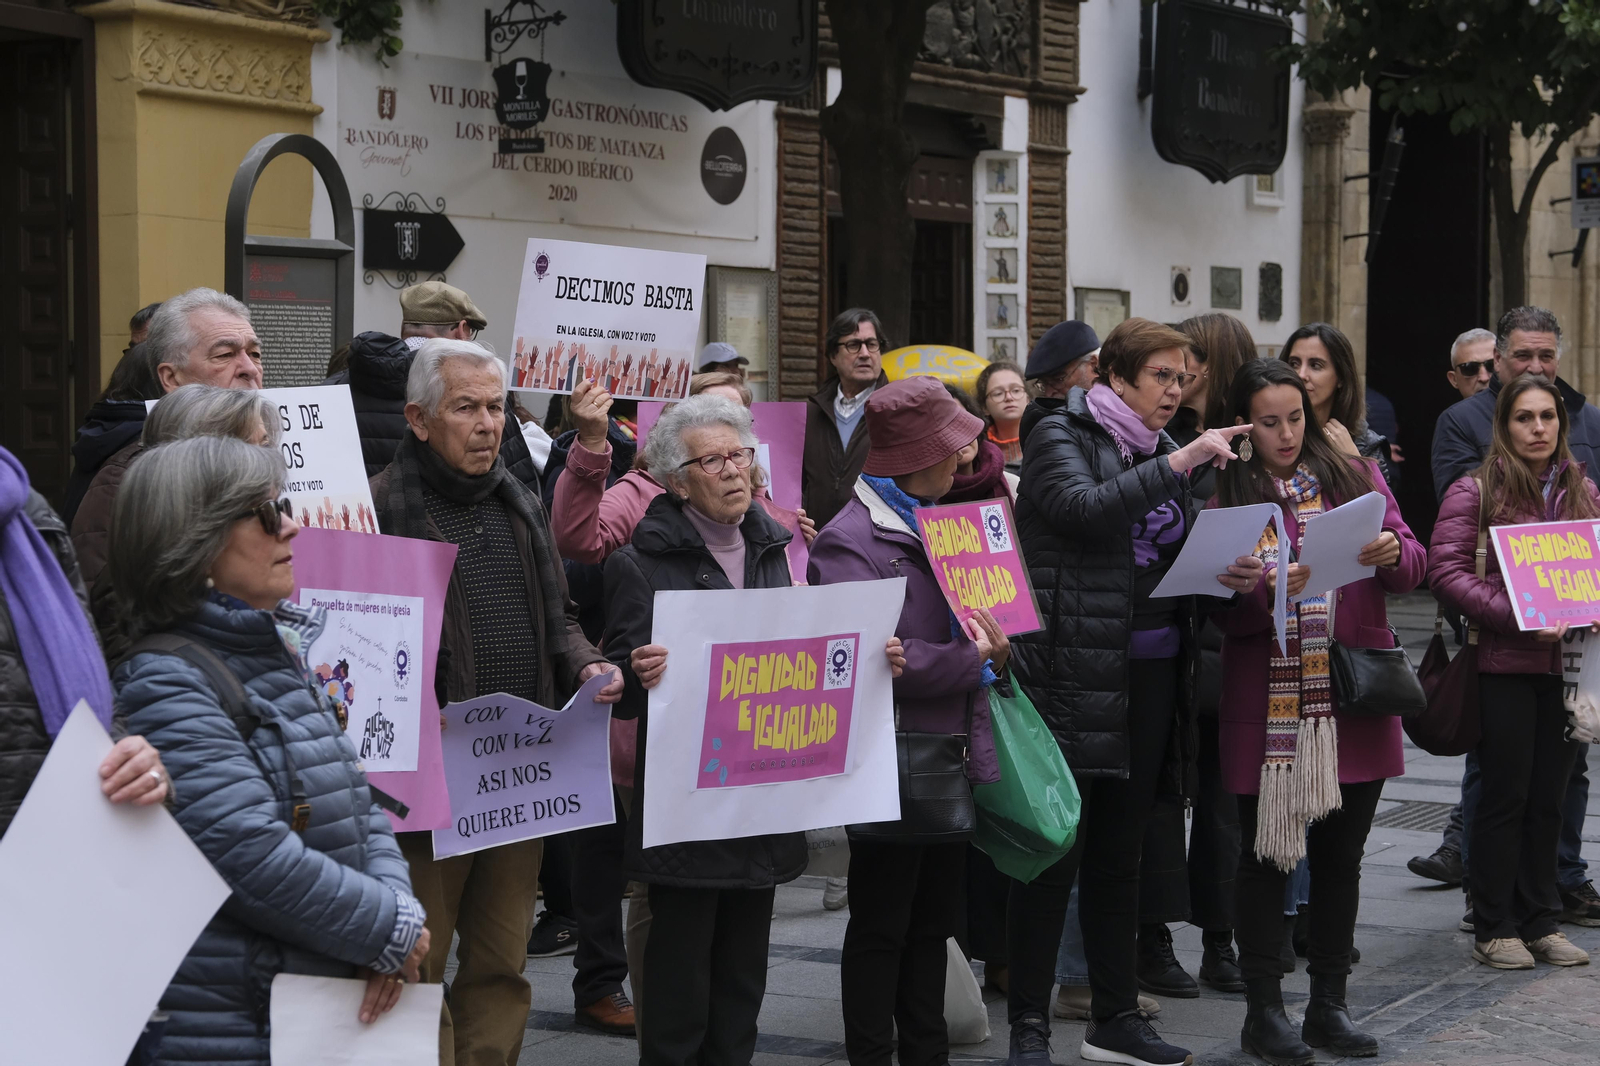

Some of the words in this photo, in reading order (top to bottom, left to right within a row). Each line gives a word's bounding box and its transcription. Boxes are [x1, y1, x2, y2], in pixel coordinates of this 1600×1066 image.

[429, 84, 454, 106] VII
[552, 98, 689, 133] GASTRONÓMICAS
[503, 101, 541, 112] MONTILLA
[506, 111, 539, 122] MORILES
[456, 121, 485, 142] LOS
[577, 135, 596, 152] DE
[600, 137, 665, 160] MATANZA
[492, 152, 519, 171] DEL
[523, 155, 574, 178] CERDO
[577, 158, 634, 182] IBÉRICO
[548, 184, 577, 202] 2020
[555, 276, 635, 306] DECIMOS
[643, 285, 694, 311] BASTA
[556, 325, 566, 335] EN
[567, 326, 577, 336] LA
[578, 327, 606, 340] IGLESIA,
[607, 330, 621, 340] CON
[621, 331, 634, 341] VOZ
[635, 332, 639, 341] Y
[640, 332, 656, 343] VOTO
[279, 405, 291, 432] S
[298, 404, 323, 430] DE
[282, 442, 304, 470] OS
[288, 482, 301, 492] VOZ
[302, 482, 307, 491] Y
[307, 480, 324, 491] VOTO
[992, 506, 1007, 535] Cristianas
[921, 516, 983, 562] DIGNIDAD
[1507, 531, 1593, 569] DIGNIDAD
[942, 561, 955, 592] E
[951, 565, 1018, 611] IGUALDAD
[1533, 565, 1551, 588] E
[1548, 567, 1600, 605] IGUAL
[345, 600, 353, 612] de
[353, 602, 380, 615] mujeres
[381, 606, 388, 614] en
[388, 604, 392, 614] la
[392, 604, 411, 617] Iglesia
[826, 641, 842, 665] Mujeres
[719, 651, 818, 702] DIGNIDAD
[363, 711, 395, 743] ALCEMOS
[464, 706, 509, 724] CON
[525, 713, 555, 730] VO
[737, 699, 752, 731] E
[753, 702, 838, 754] IGUALDAD
[359, 737, 372, 760] LA
[472, 733, 508, 758] CON
[477, 770, 509, 795] ASI
[512, 761, 552, 787] NOS
[457, 804, 528, 836] QUIERE
[532, 794, 582, 820] DIOS
[806, 839, 836, 850] RDOBA
